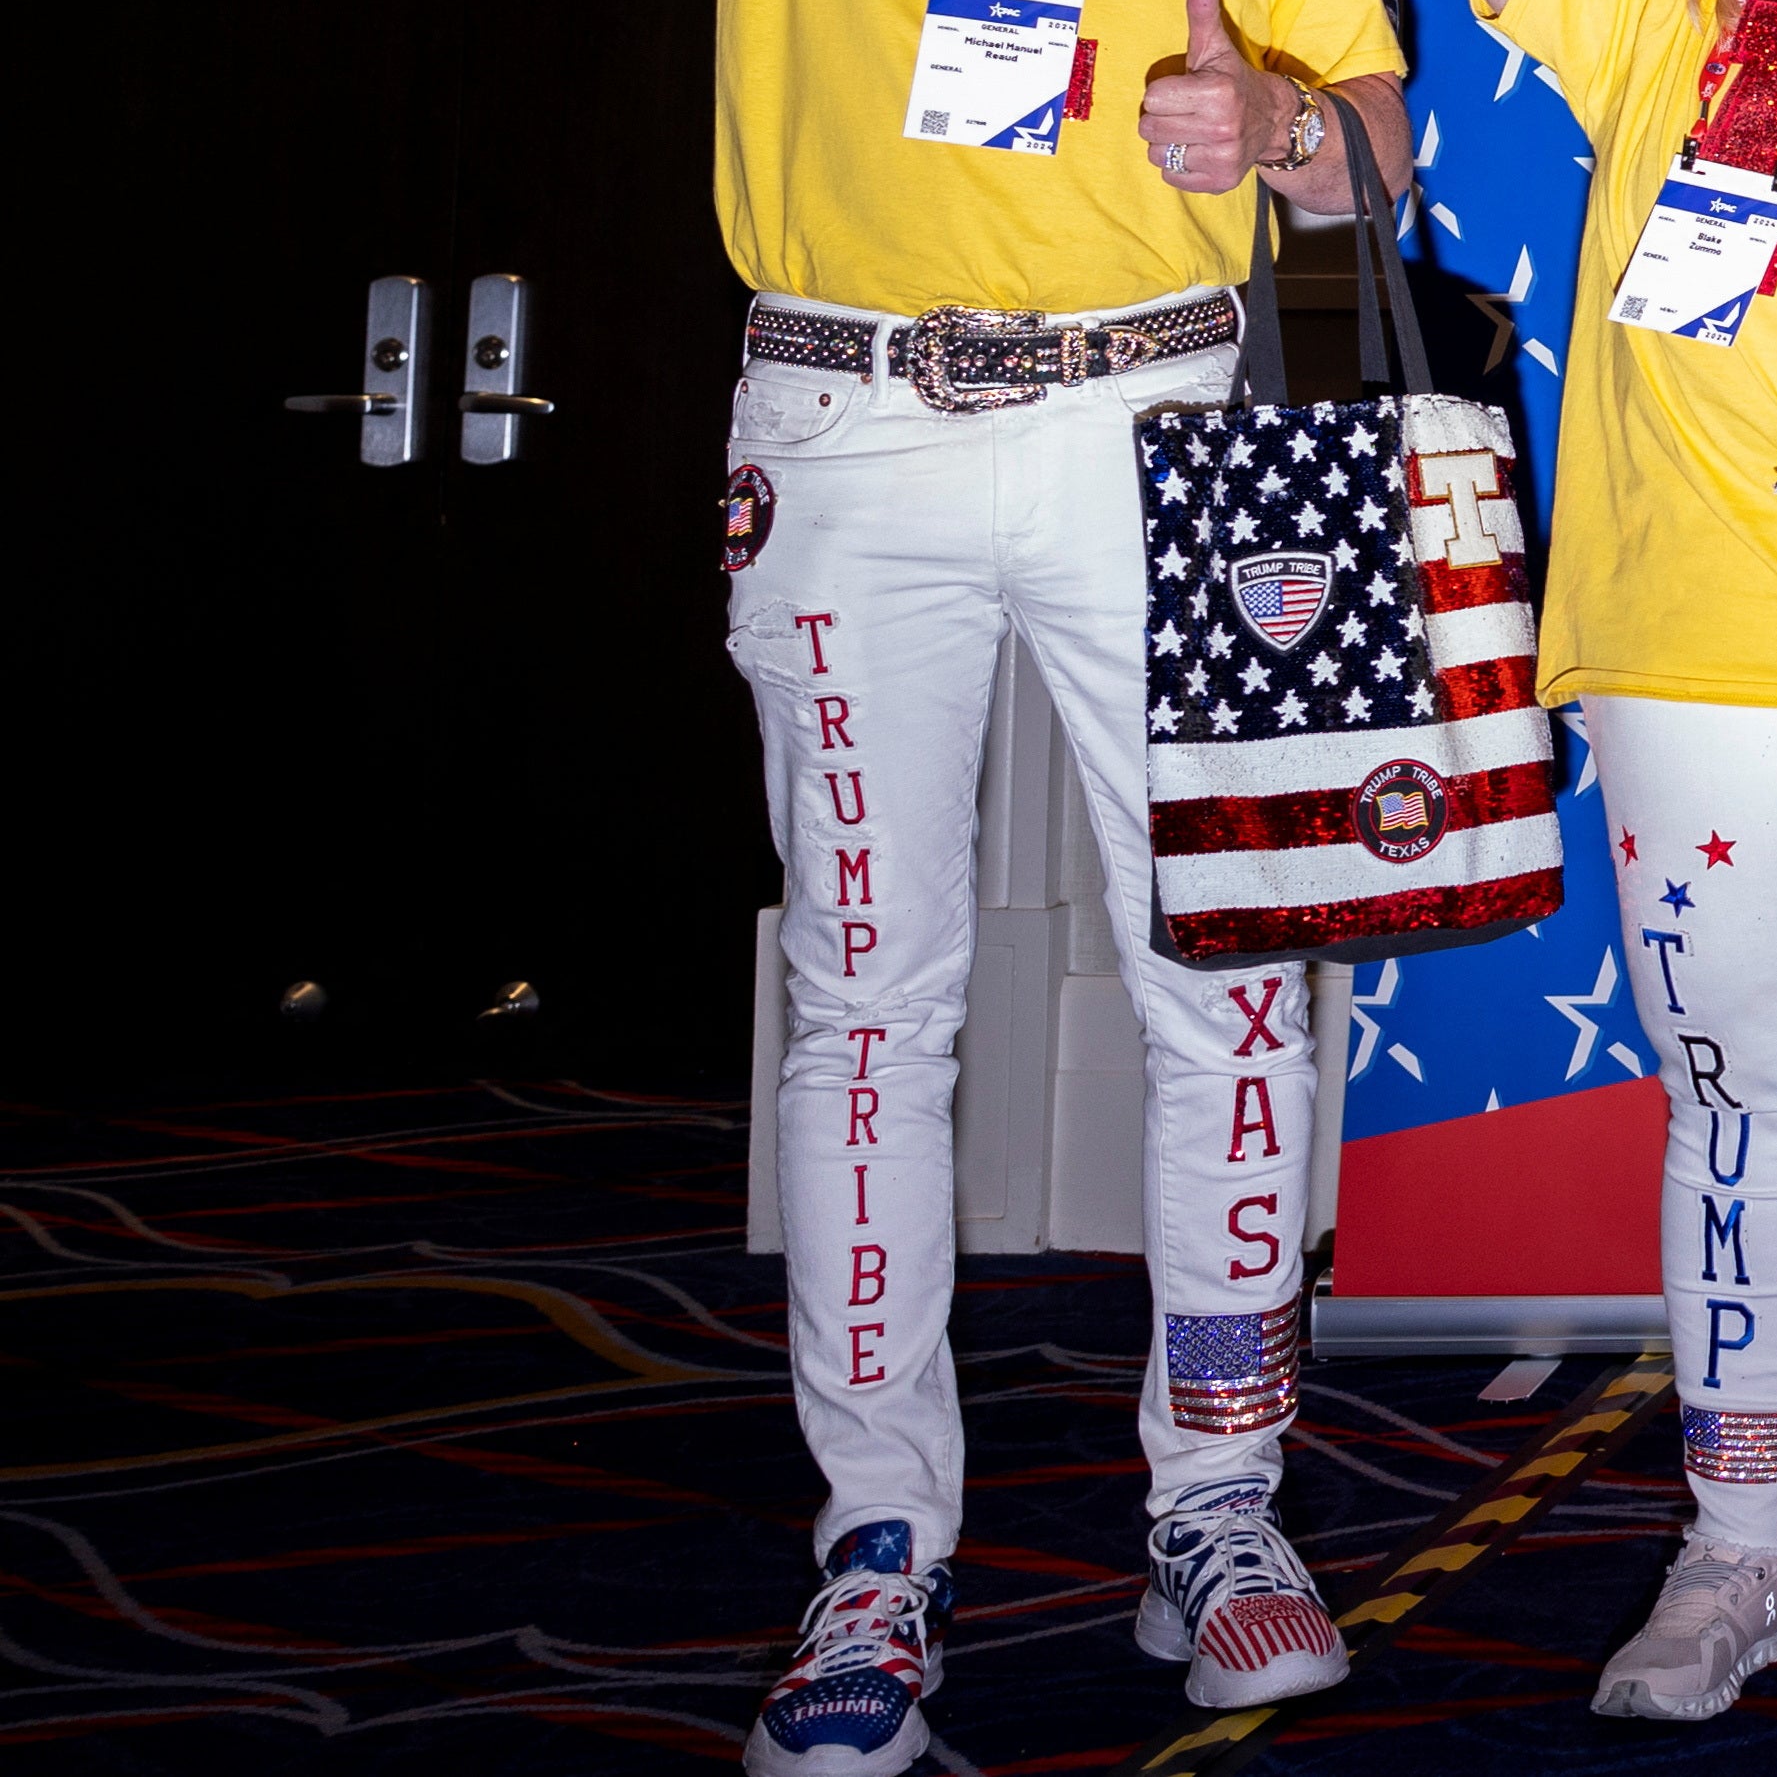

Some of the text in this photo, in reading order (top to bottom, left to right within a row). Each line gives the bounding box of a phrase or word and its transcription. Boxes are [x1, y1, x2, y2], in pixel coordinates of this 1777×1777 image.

[981, 24, 1019, 35] GENERAL
[964, 36, 1043, 55] Michael Manuel
[985, 51, 1018, 62] Reaud
[1695, 216, 1726, 229] GENERAL
[1753, 217, 1776, 227] 2024
[1697, 232, 1722, 244] Blake
[1642, 252, 1669, 262] GENERAL
[1689, 242, 1722, 256] Zummo
[750, 472, 770, 505] TRIBE
[1419, 448, 1500, 568] T
[1242, 561, 1322, 579] TRUMP TRIBE
[1360, 765, 1443, 804] TRUMP TRIBE
[795, 612, 877, 978] TRUMP
[1378, 836, 1430, 859] TEXAS
[1227, 976, 1285, 1281] XAS
[1642, 927, 1756, 1390] TRUMP
[846, 1028, 886, 1386] TRIBE
[1243, 1610, 1301, 1628] AGAIN
[792, 1699, 889, 1722] TRUMP
